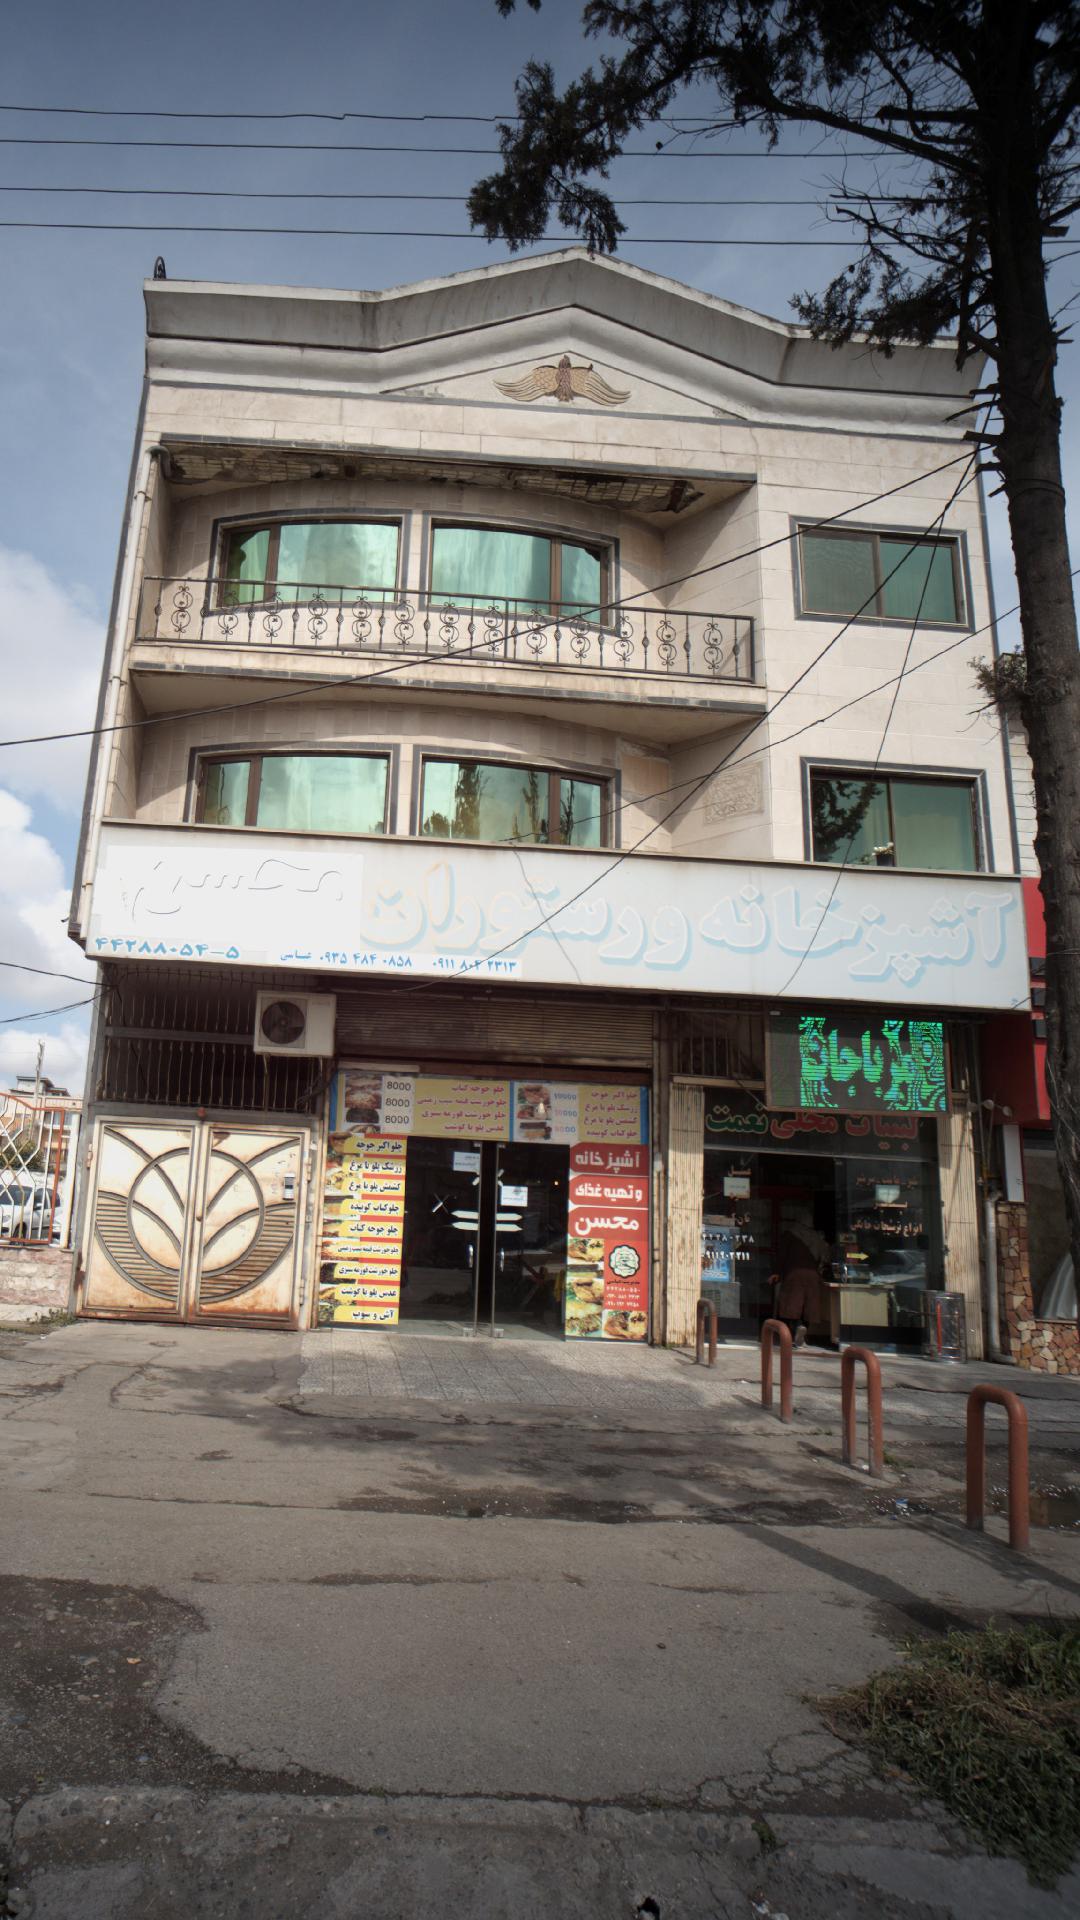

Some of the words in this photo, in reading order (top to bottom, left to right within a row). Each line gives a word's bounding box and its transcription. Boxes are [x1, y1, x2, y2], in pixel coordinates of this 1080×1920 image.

[320, 951, 348, 965] ۰۹۳۵
[353, 952, 377, 965] ۴۸۴
[383, 955, 412, 967] ۰۸۵۸
[433, 957, 455, 969] ۰۹۱۱
[386, 1080, 411, 1091] 8000
[386, 1098, 410, 1108] 8000
[385, 1115, 410, 1125] 8000
[705, 1103, 769, 1135] نعمت
[575, 1182, 602, 1198] غذای
[604, 1184, 634, 1202] تهیه
[575, 1216, 640, 1236] محسن
